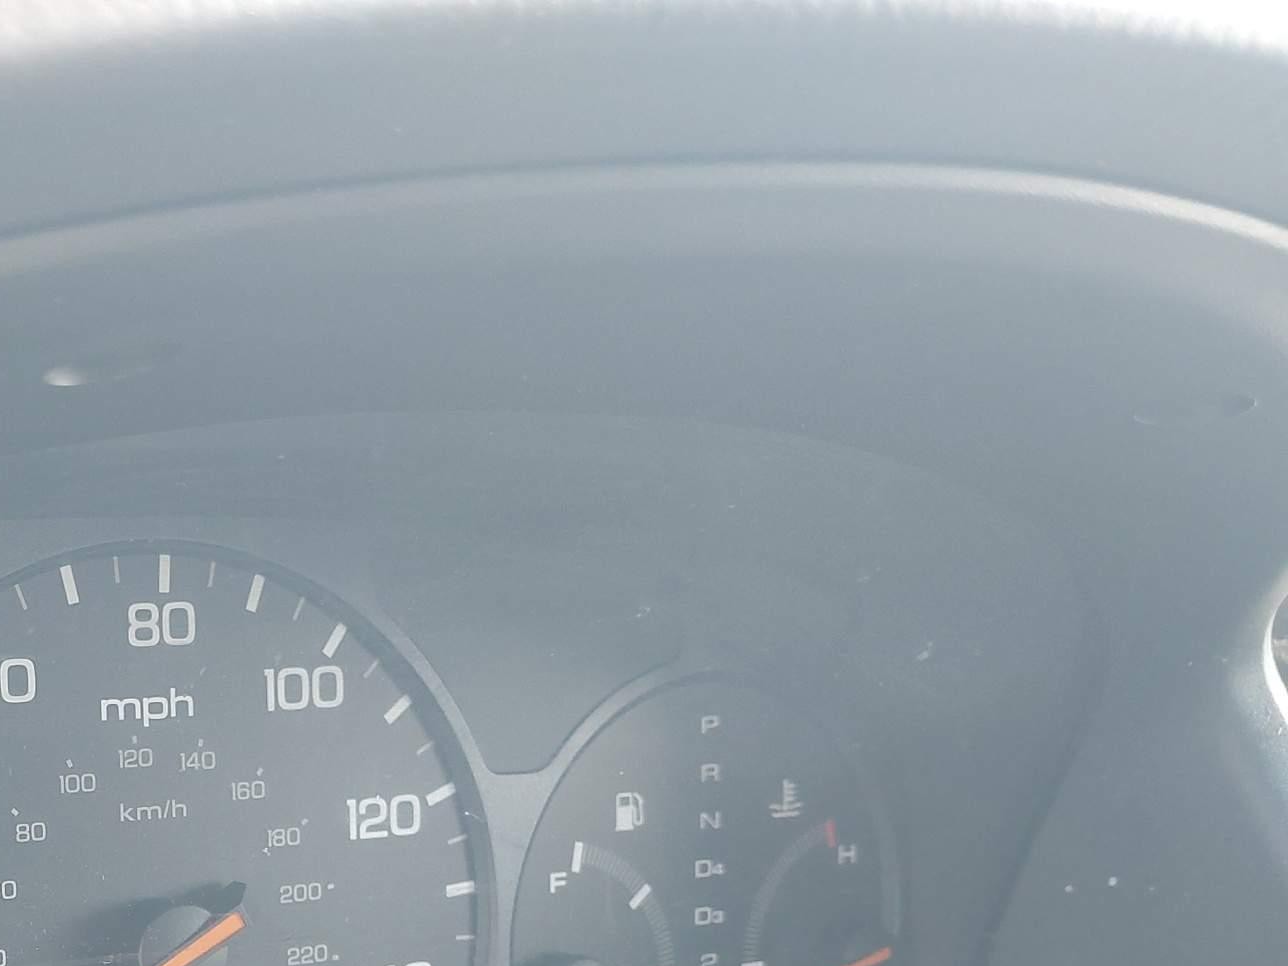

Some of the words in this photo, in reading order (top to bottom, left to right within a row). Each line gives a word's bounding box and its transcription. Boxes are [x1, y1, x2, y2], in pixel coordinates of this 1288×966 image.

[127, 601, 196, 647] 80
[263, 666, 344, 711] 100
[100, 687, 195, 726] mph
[700, 715, 720, 734] P
[117, 747, 154, 769] 120
[179, 751, 217, 772] 140
[58, 773, 97, 794] 100
[700, 763, 720, 783] R
[230, 780, 266, 802] 160
[118, 800, 188, 822] km/h
[346, 795, 421, 840] 120
[699, 811, 721, 830] N
[14, 822, 47, 843] 80
[266, 827, 301, 849] 180
[838, 845, 857, 864] H
[279, 882, 322, 903] 200
[549, 872, 567, 894] F
[286, 945, 329, 965] 220
